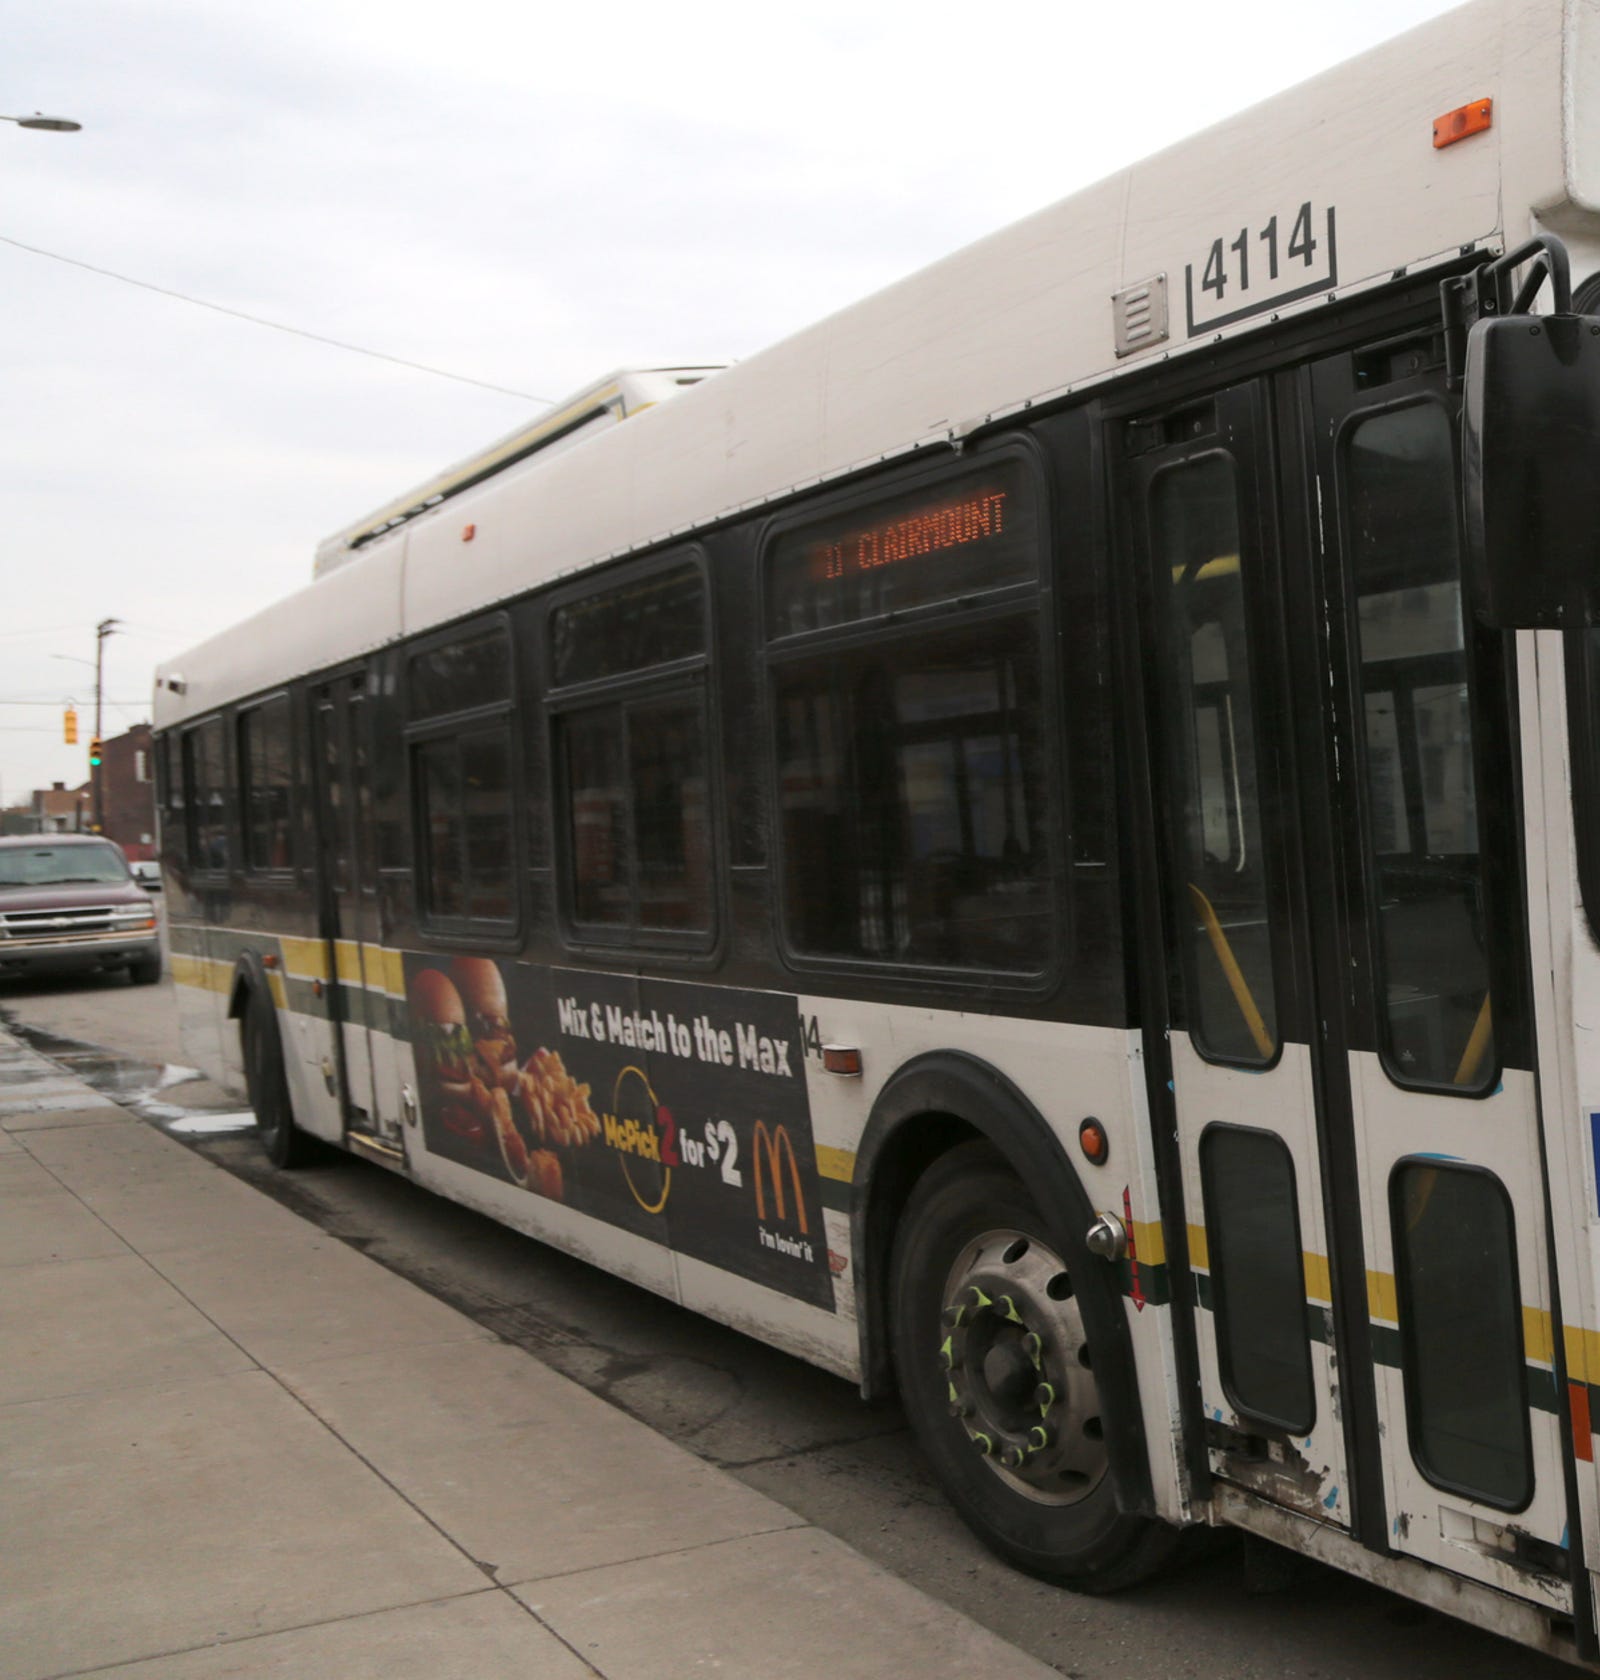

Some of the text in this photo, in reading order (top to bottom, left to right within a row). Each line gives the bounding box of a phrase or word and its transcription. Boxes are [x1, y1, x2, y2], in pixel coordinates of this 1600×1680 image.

[1201, 200, 1317, 300] 4114
[858, 491, 1006, 569] CLAIRMOUNT
[557, 997, 793, 1078] Mix & Match to the Max
[679, 1127, 706, 1169] for
[704, 1117, 743, 1189] $2
